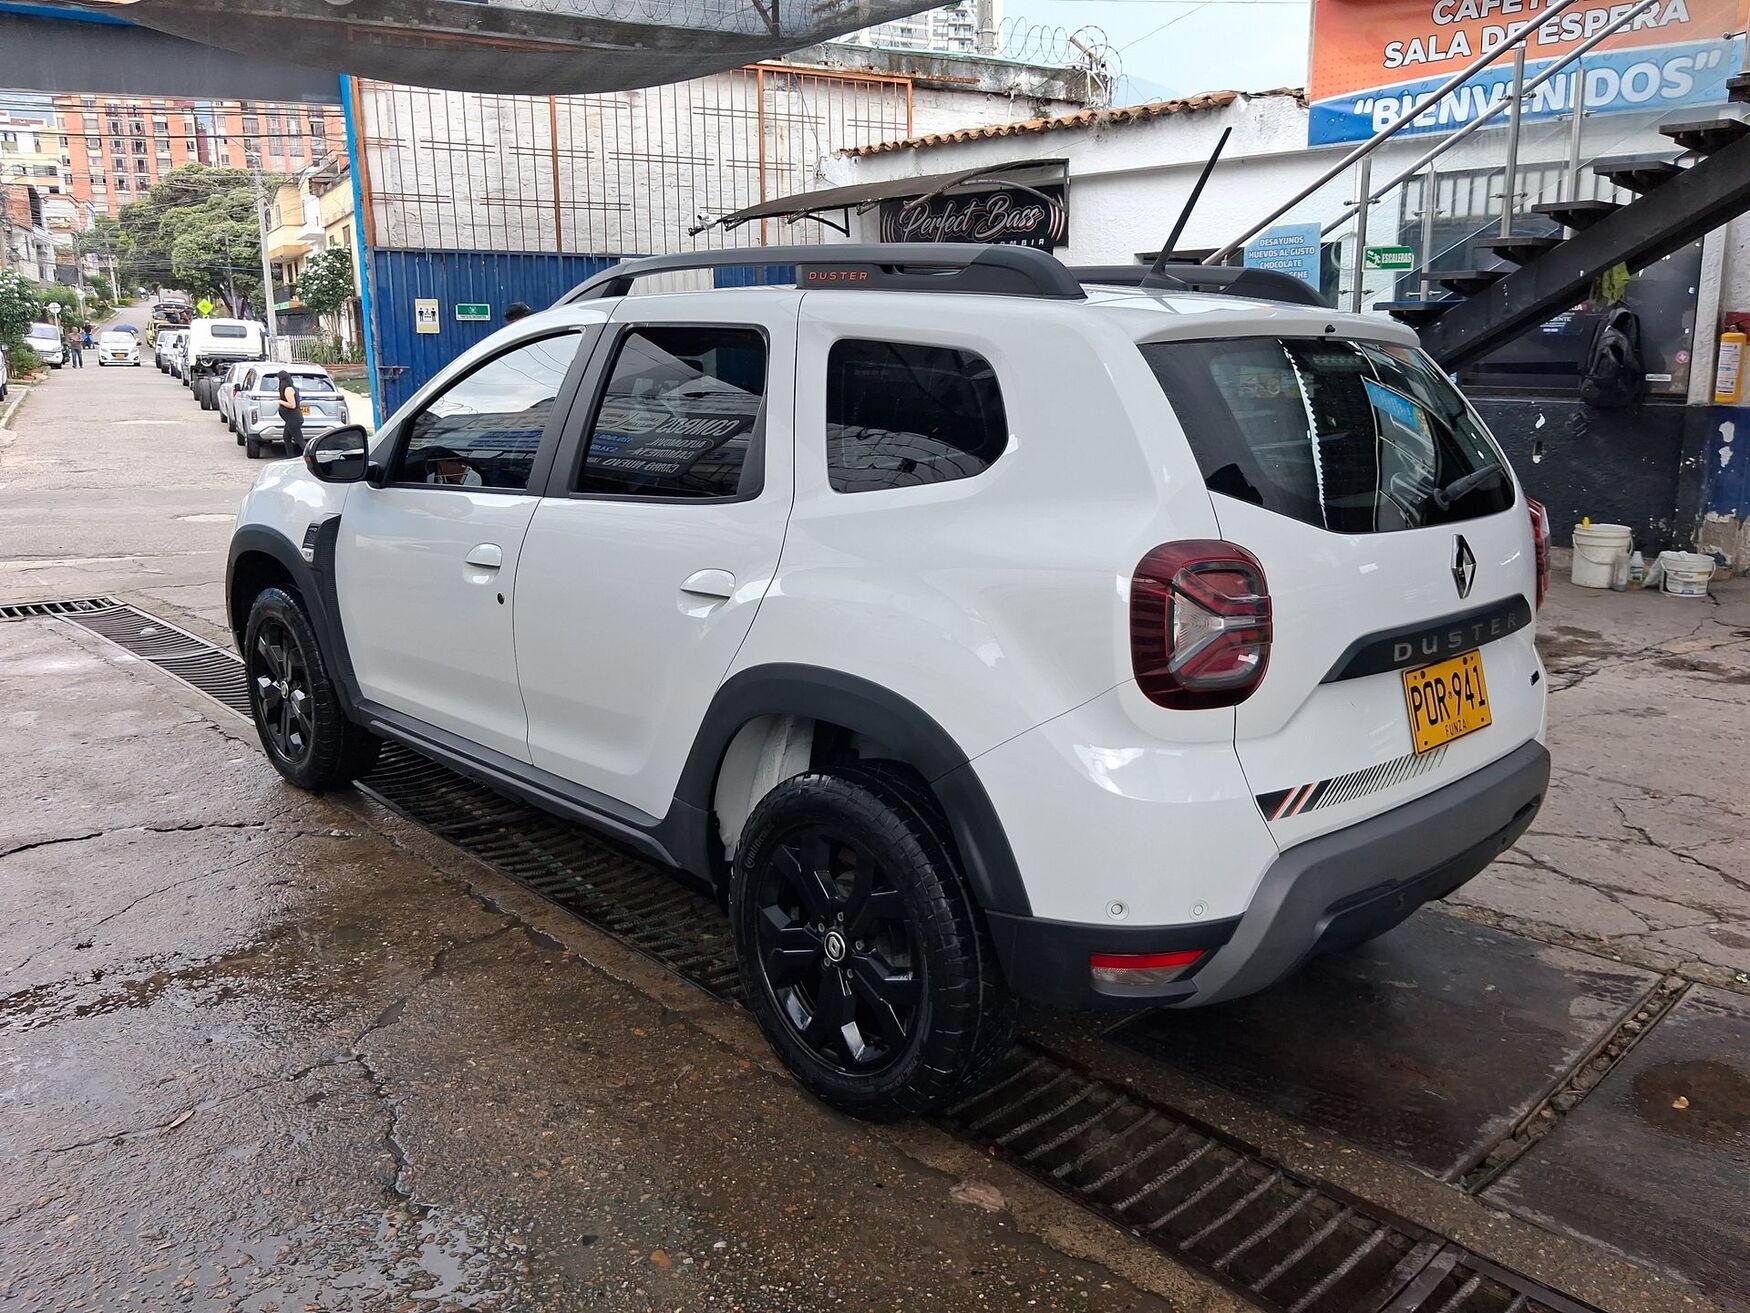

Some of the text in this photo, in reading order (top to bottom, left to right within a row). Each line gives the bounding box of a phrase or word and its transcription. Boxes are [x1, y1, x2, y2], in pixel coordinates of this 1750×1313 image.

[1383, 1, 1690, 68] SALA DE ESPERA
[899, 194, 1044, 242] Perfect Bass
[1259, 235, 1304, 247] DESAYUNOS
[1248, 246, 1315, 259] HUEVOS AL GUSTO
[1259, 259, 1303, 269] CHOCOLATE
[809, 271, 868, 280] DUSTER
[1393, 613, 1517, 662] DUSTER
